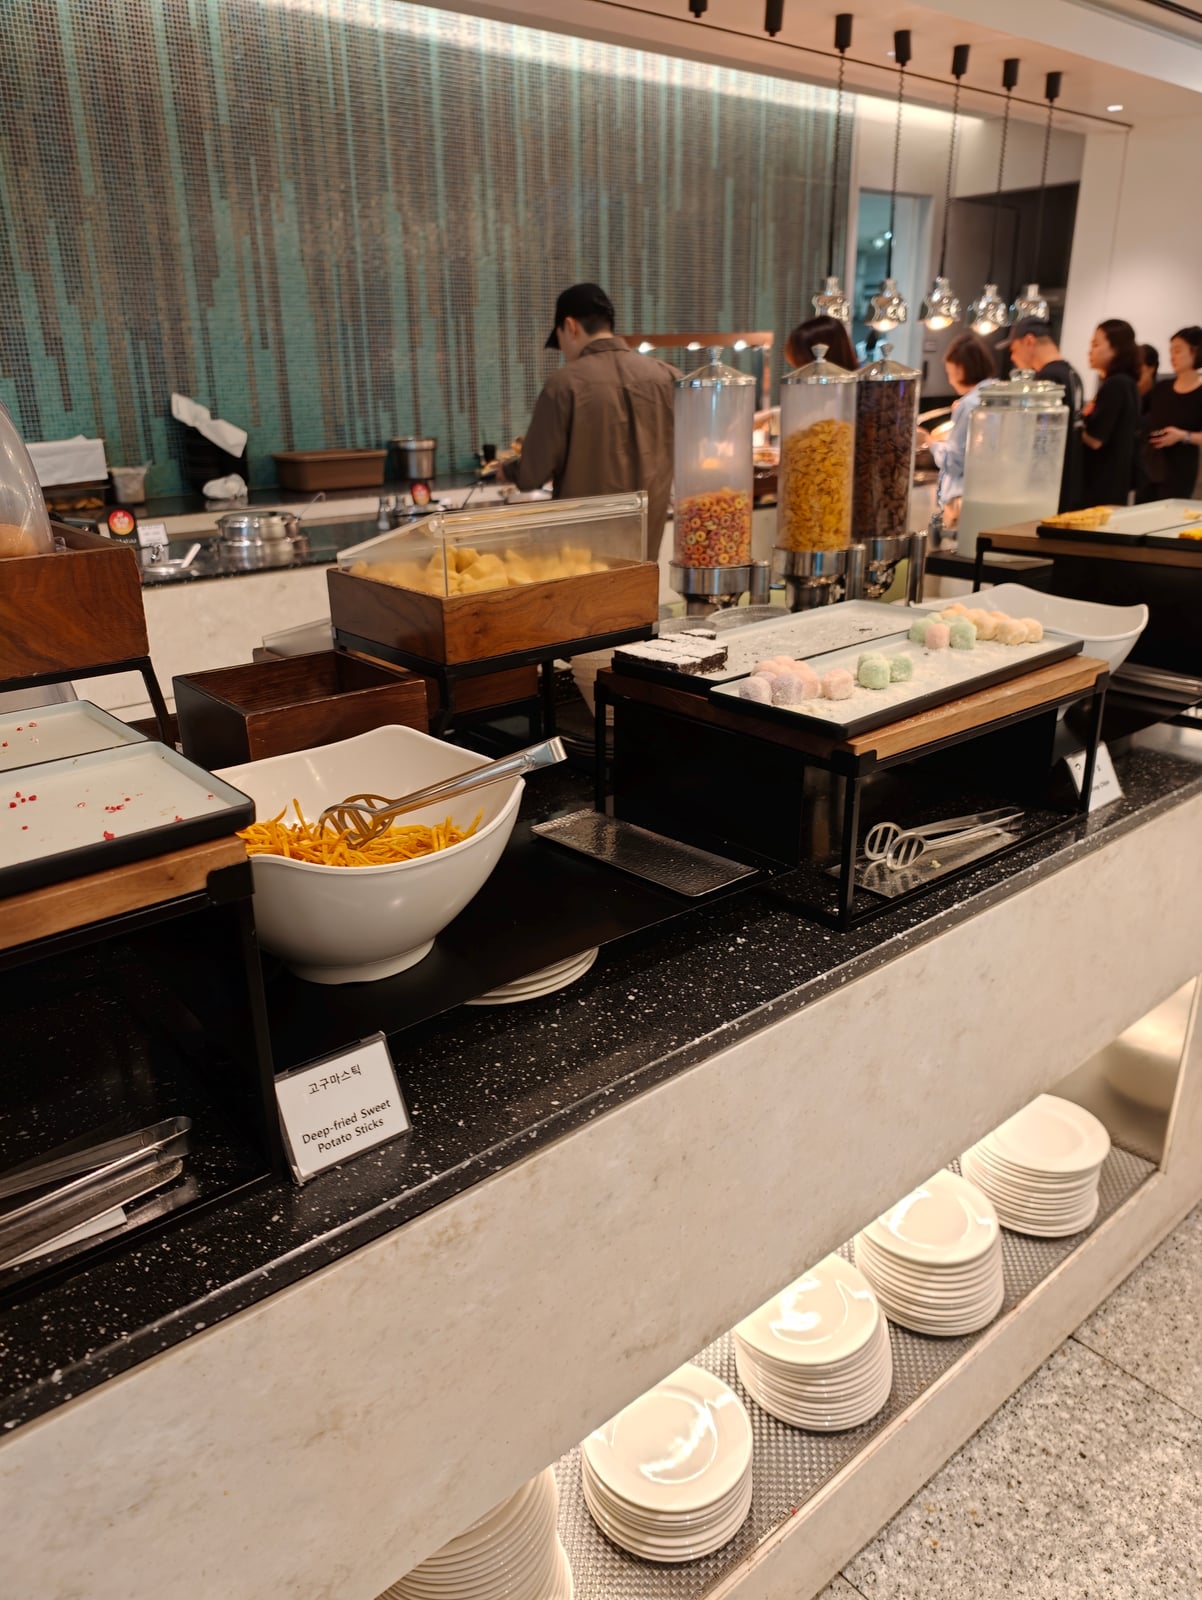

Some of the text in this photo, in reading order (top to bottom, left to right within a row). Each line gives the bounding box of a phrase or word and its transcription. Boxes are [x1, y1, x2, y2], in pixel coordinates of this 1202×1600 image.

[308, 1064, 362, 1094] 고구마스틱
[302, 1099, 391, 1144] Deep-fried Sweet
[317, 1118, 384, 1153] Potato Sticks
